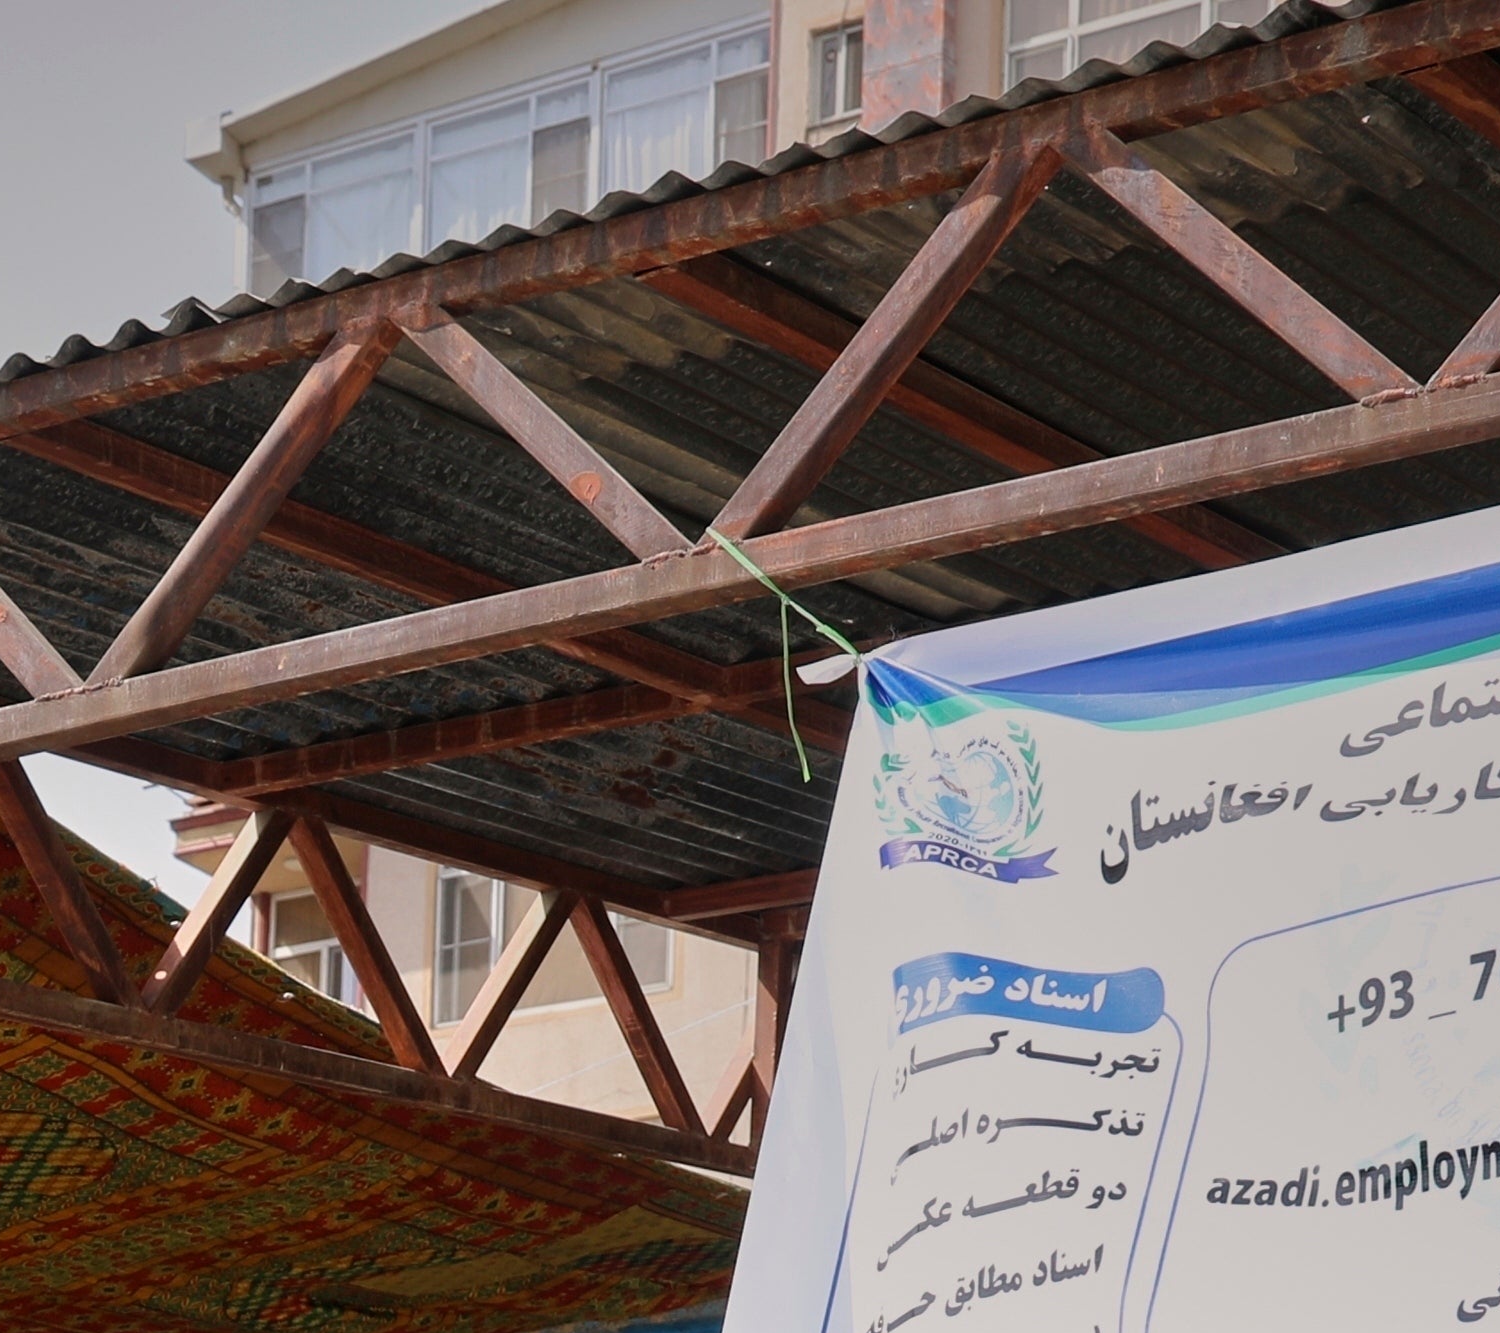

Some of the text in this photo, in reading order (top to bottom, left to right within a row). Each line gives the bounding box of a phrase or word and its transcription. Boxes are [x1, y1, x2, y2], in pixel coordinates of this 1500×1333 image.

[1100, 781, 1314, 885] افغانستان
[904, 844, 998, 879] APRCA
[894, 965, 1108, 1026] اسناد ضروری
[1326, 971, 1415, 1034] +93
[1016, 1039, 1161, 1078] تجربه
[977, 1109, 1145, 1144] تذکره
[877, 1168, 1127, 1272] دو قطعه عکس
[944, 1264, 1023, 1317] مطابق
[1032, 1244, 1104, 1287] اسناد
